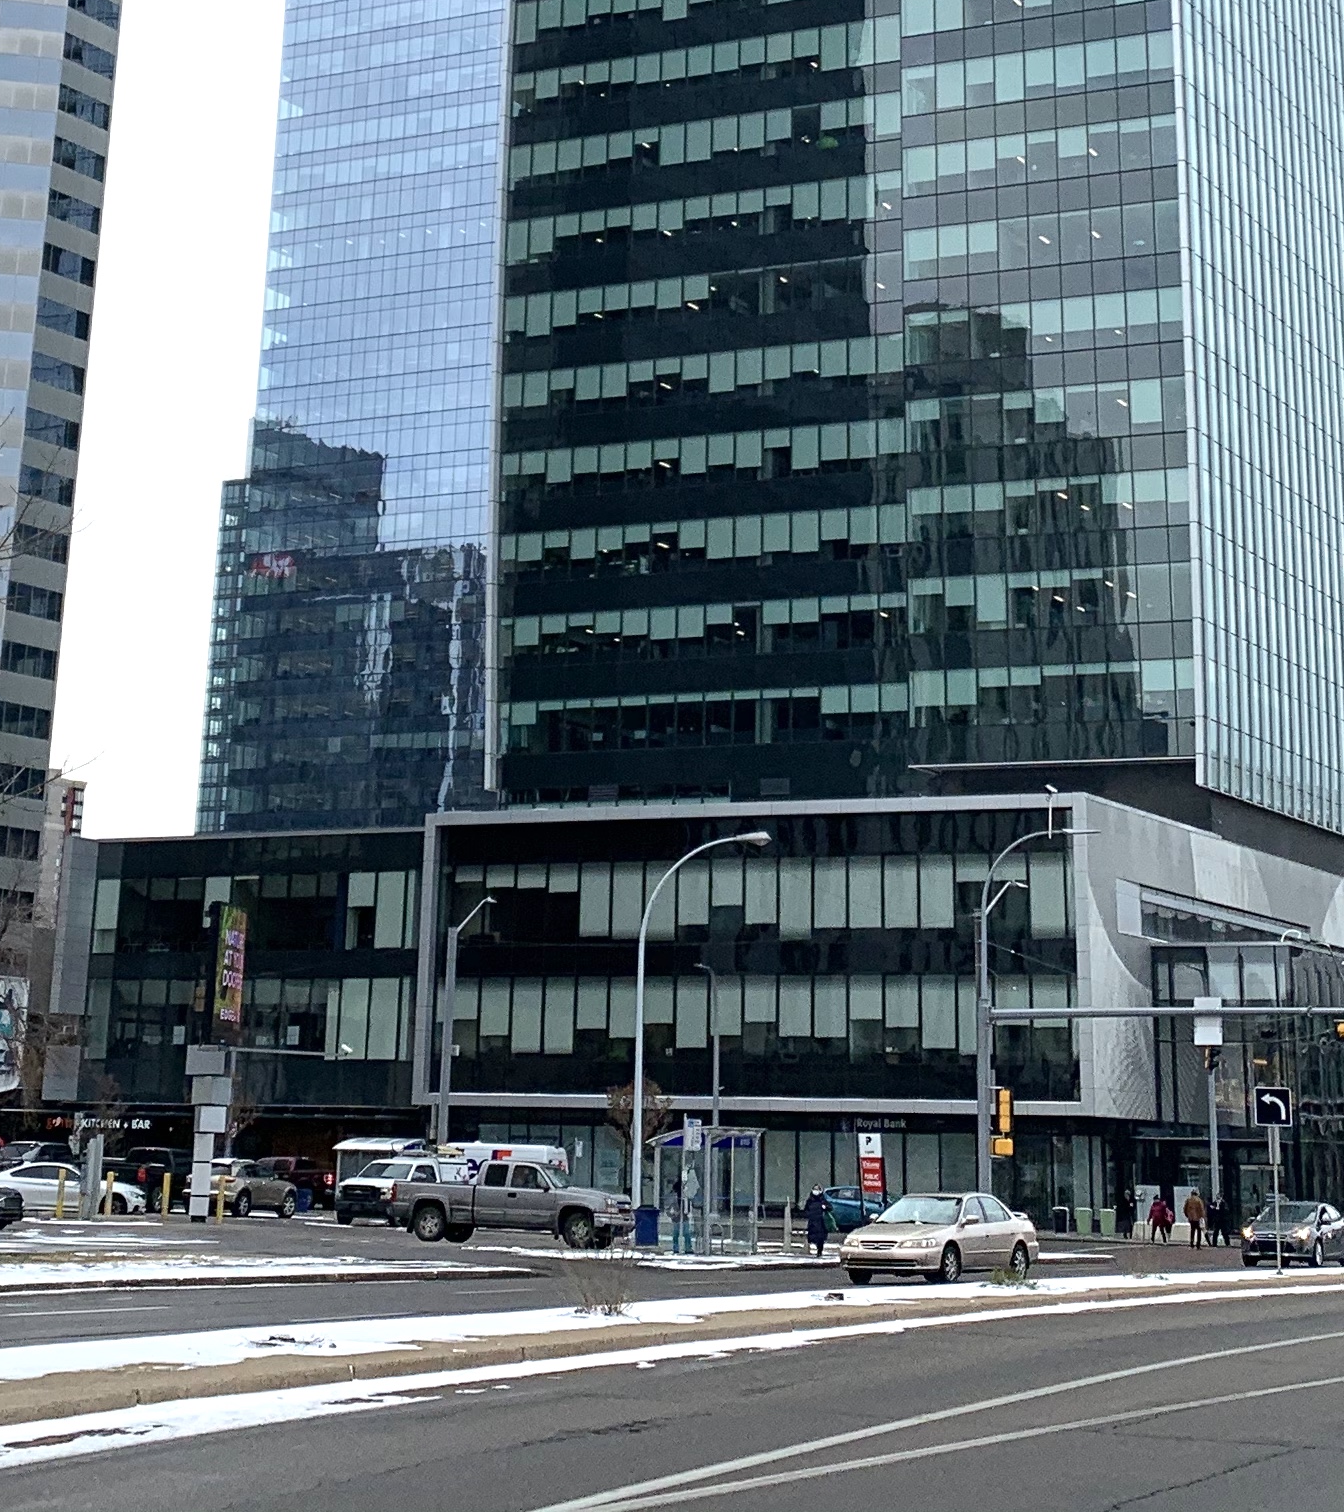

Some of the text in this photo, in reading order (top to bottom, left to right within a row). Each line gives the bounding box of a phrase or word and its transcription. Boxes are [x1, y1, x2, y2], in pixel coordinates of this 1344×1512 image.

[80, 1118, 121, 1129] KITCHEN
[131, 1118, 151, 1130] BAR
[857, 1117, 907, 1130] Royal Bank
[865, 1136, 872, 1146] P
